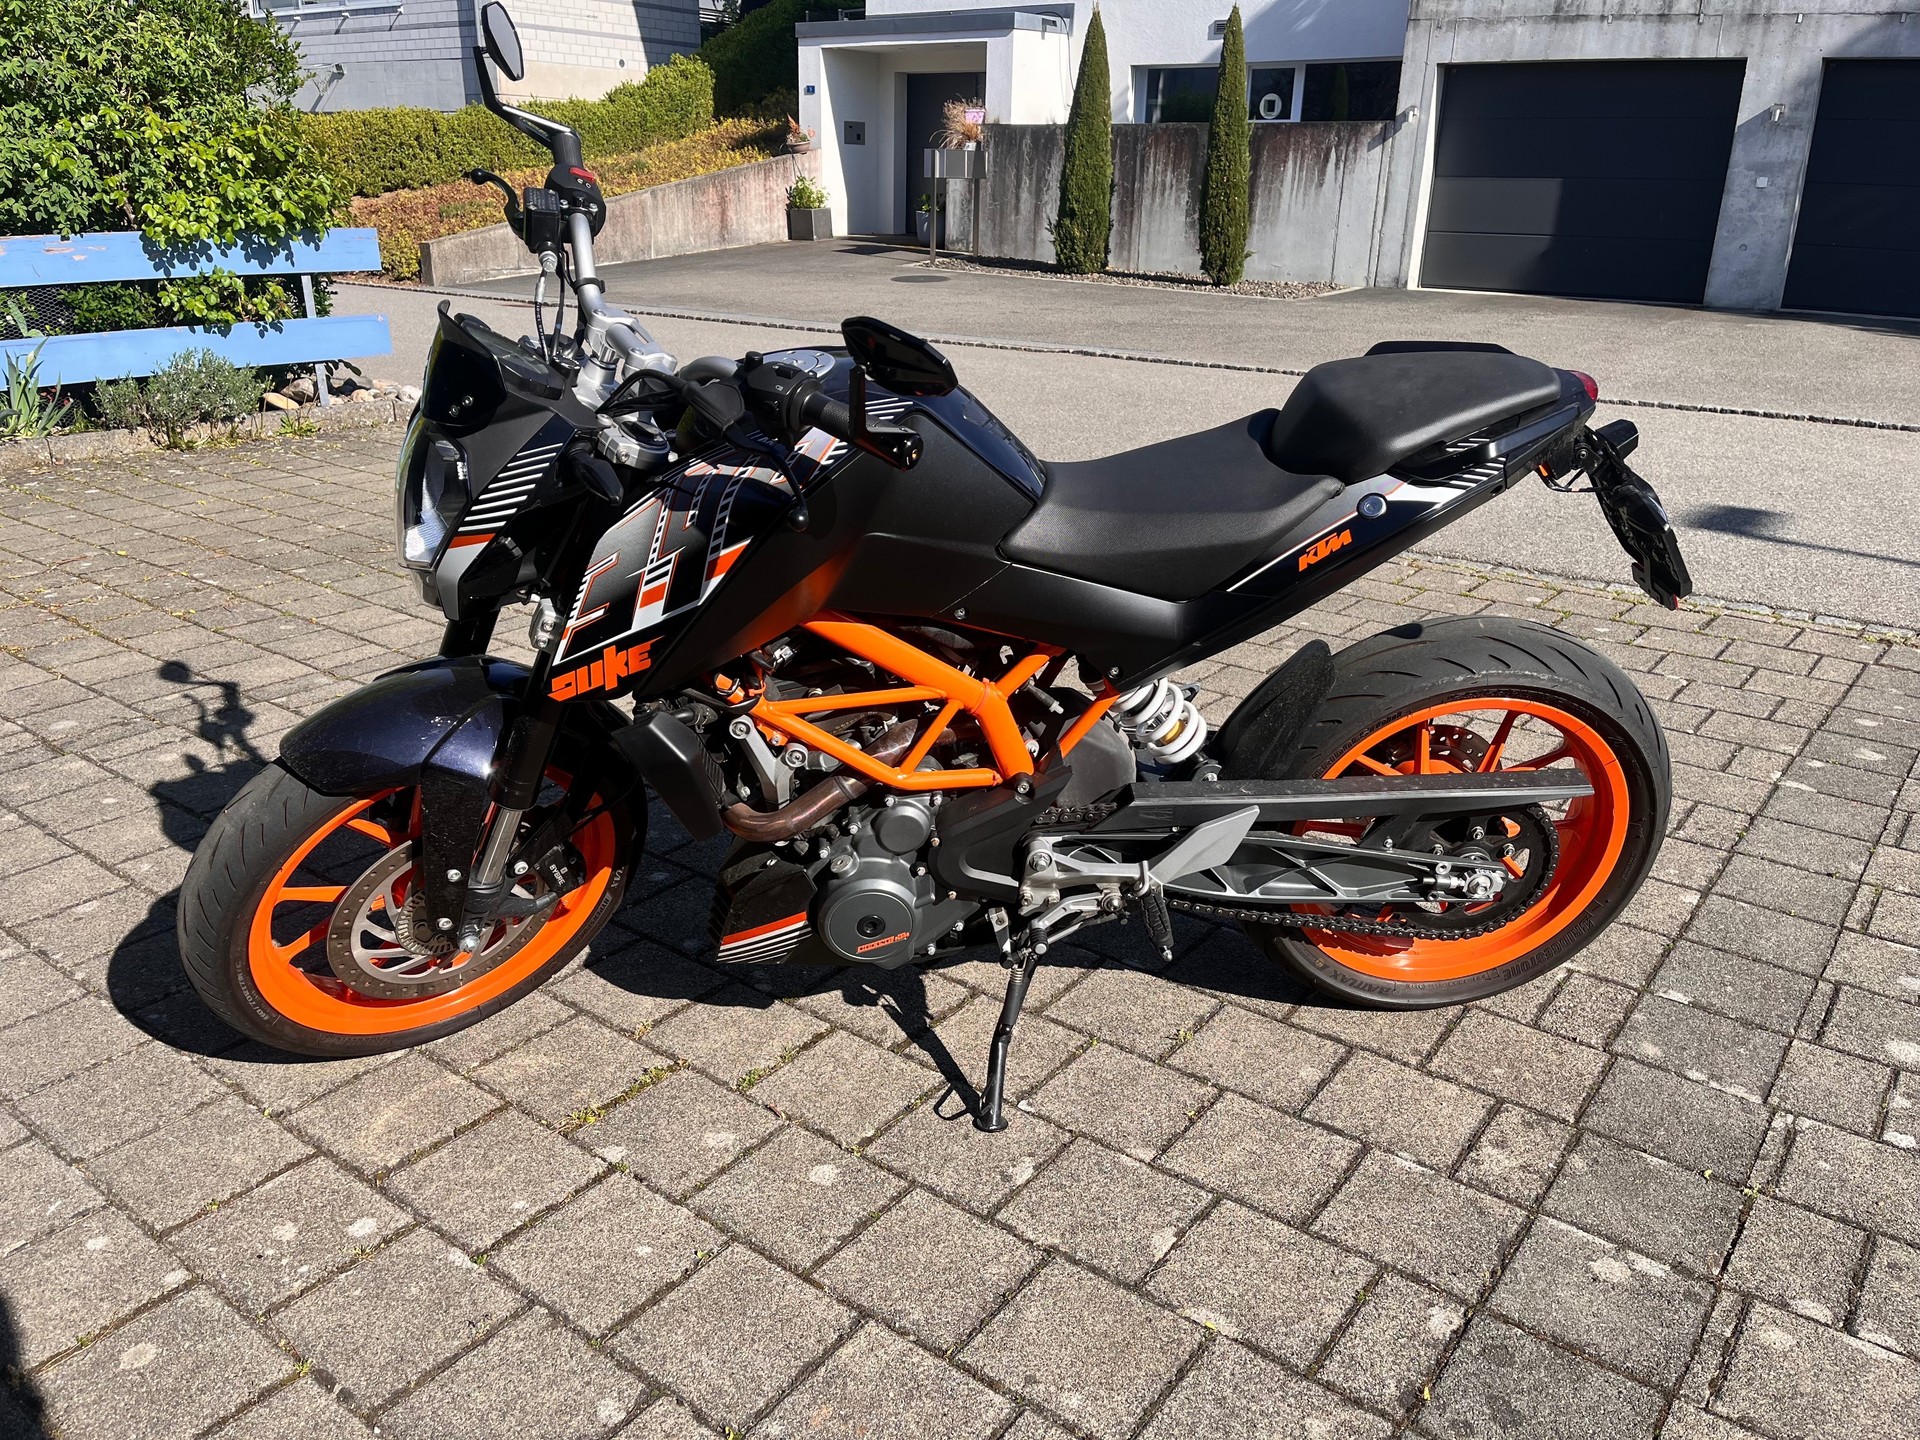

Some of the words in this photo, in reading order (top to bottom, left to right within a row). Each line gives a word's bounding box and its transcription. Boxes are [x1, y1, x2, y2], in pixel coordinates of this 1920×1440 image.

[1299, 529, 1352, 572] KTM
[549, 863, 566, 886] BYBRE
[1502, 915, 1595, 981] BRIDGESTONE
